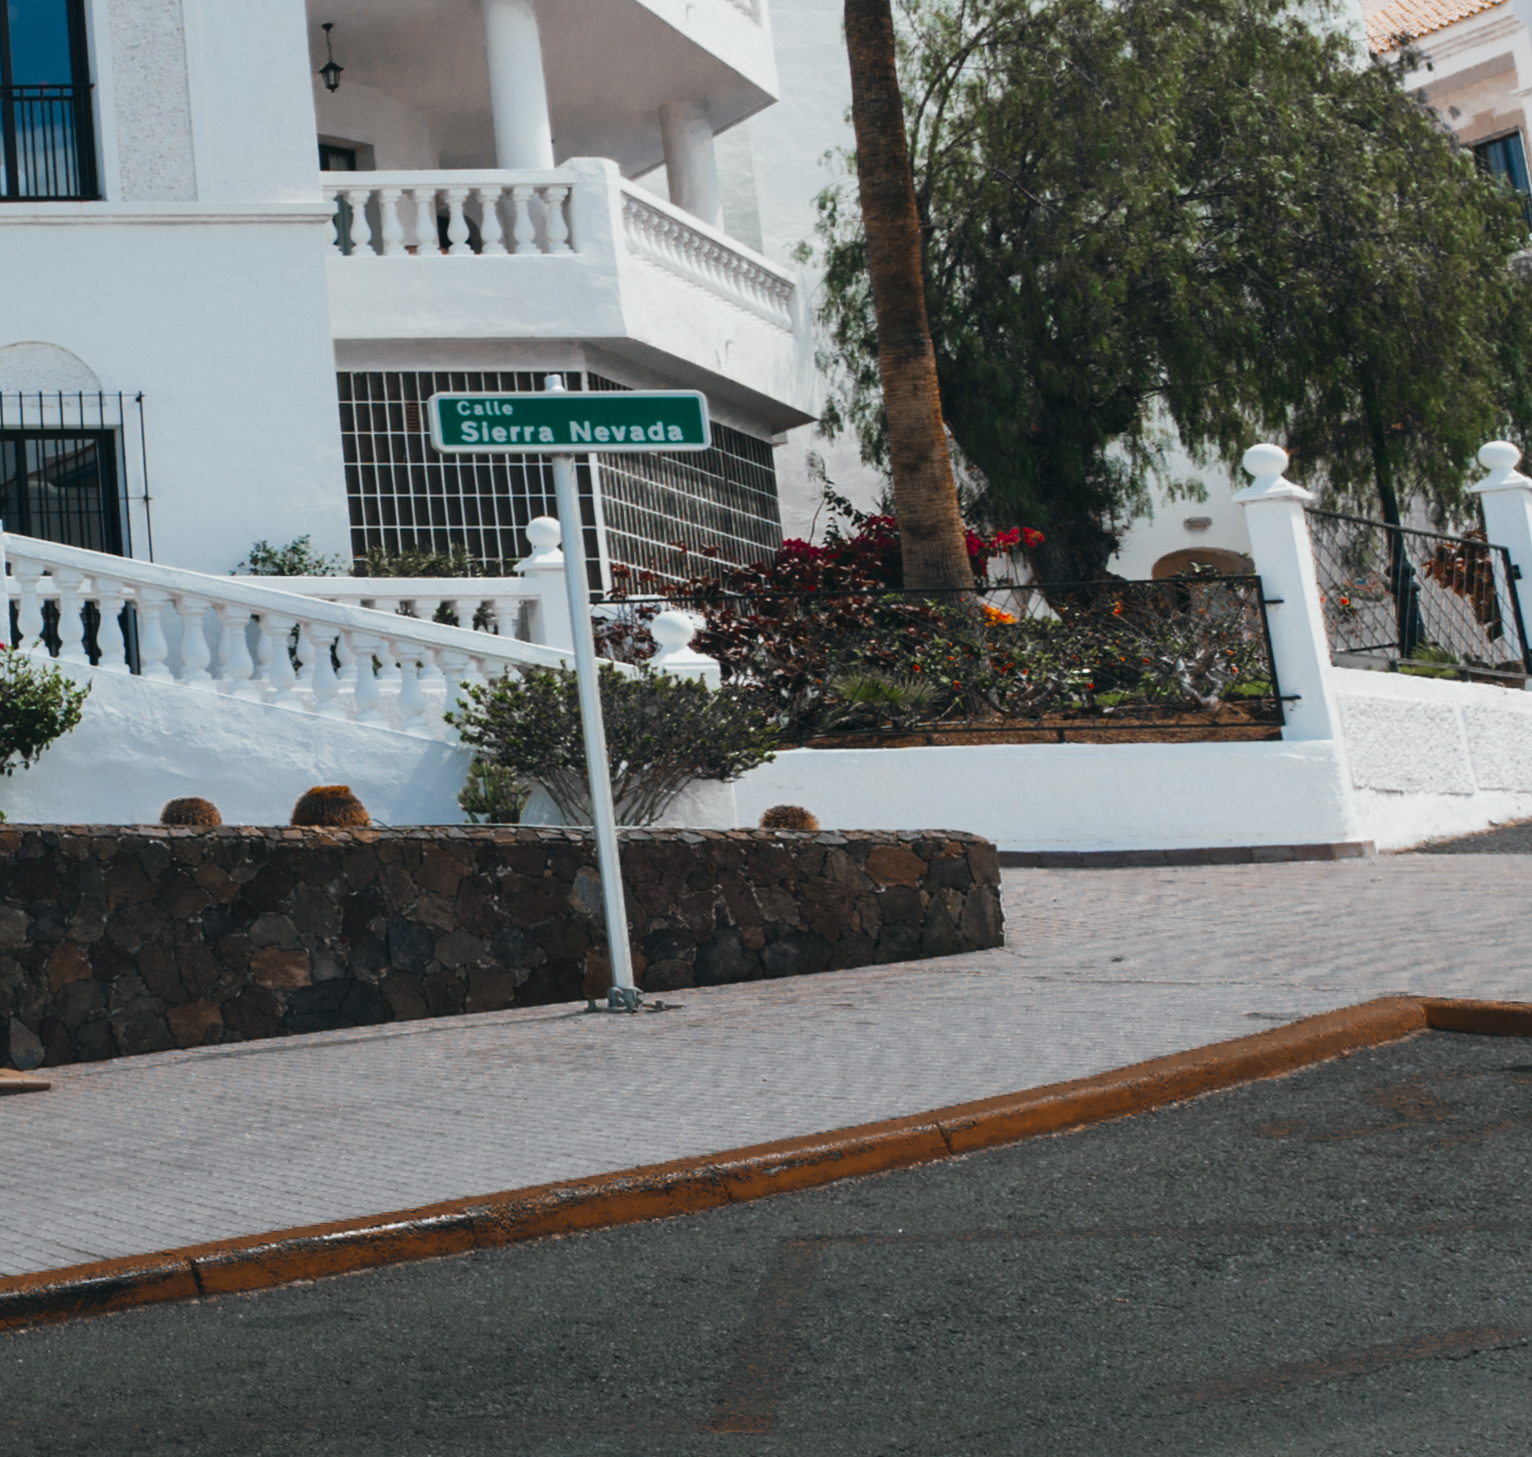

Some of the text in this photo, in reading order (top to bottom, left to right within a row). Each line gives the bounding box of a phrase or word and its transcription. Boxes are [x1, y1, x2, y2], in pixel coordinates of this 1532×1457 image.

[456, 400, 514, 416] Calle
[460, 421, 684, 443] Sierra Nevada
